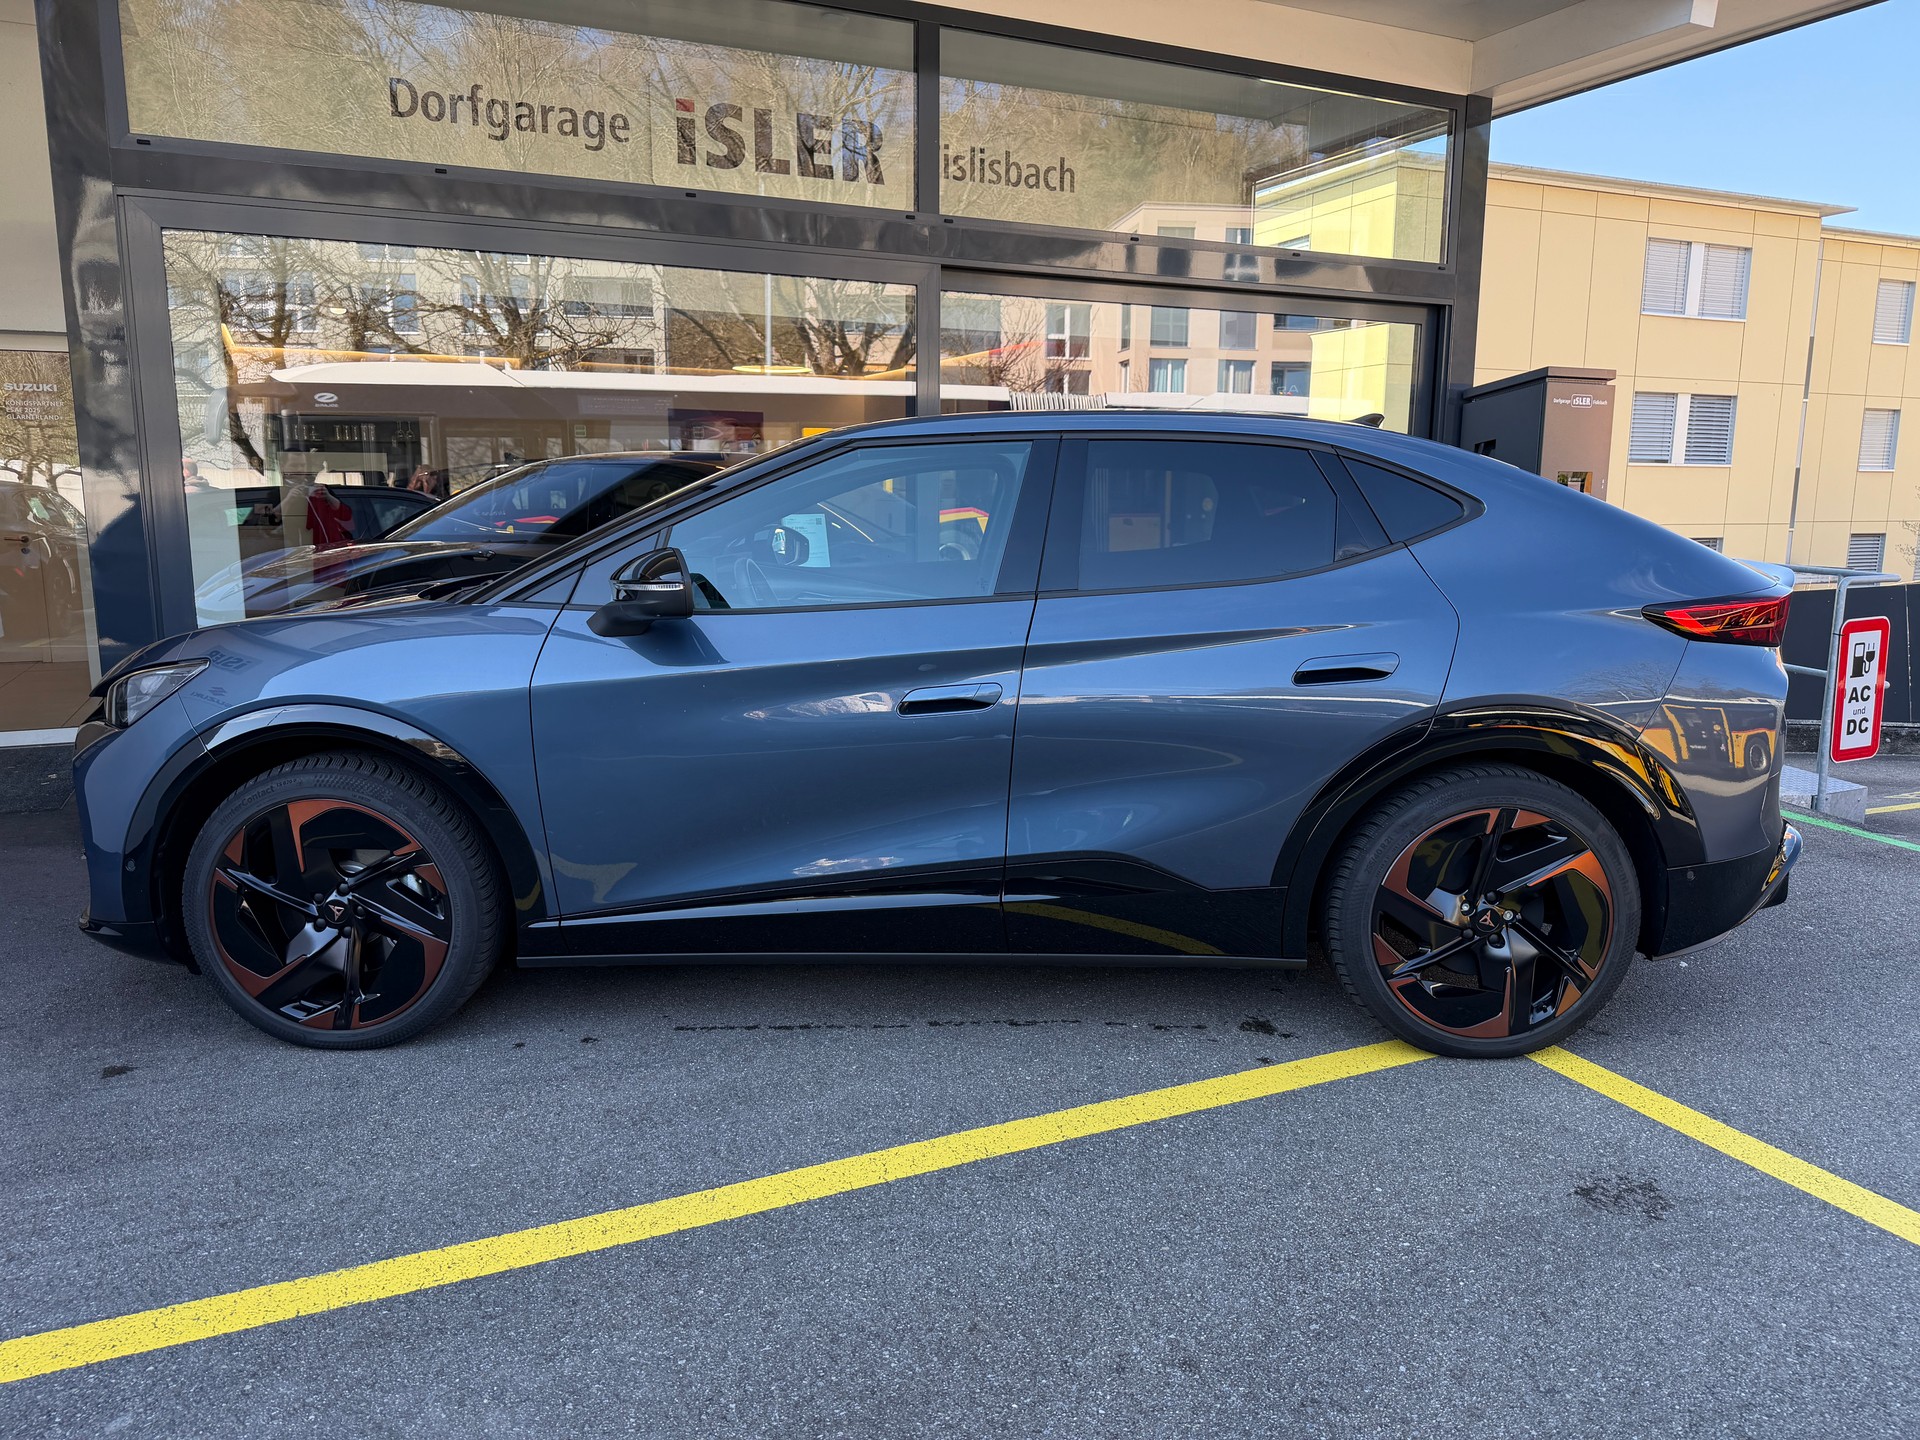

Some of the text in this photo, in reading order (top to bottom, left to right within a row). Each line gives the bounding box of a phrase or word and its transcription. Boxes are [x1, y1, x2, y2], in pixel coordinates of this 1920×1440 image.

[389, 77, 1076, 193] Dorfgarage iSLER islisbach
[3, 382, 58, 392] SUZUKI
[1848, 685, 1871, 703] AC
[1852, 706, 1866, 715] und
[1846, 717, 1869, 736] DC
